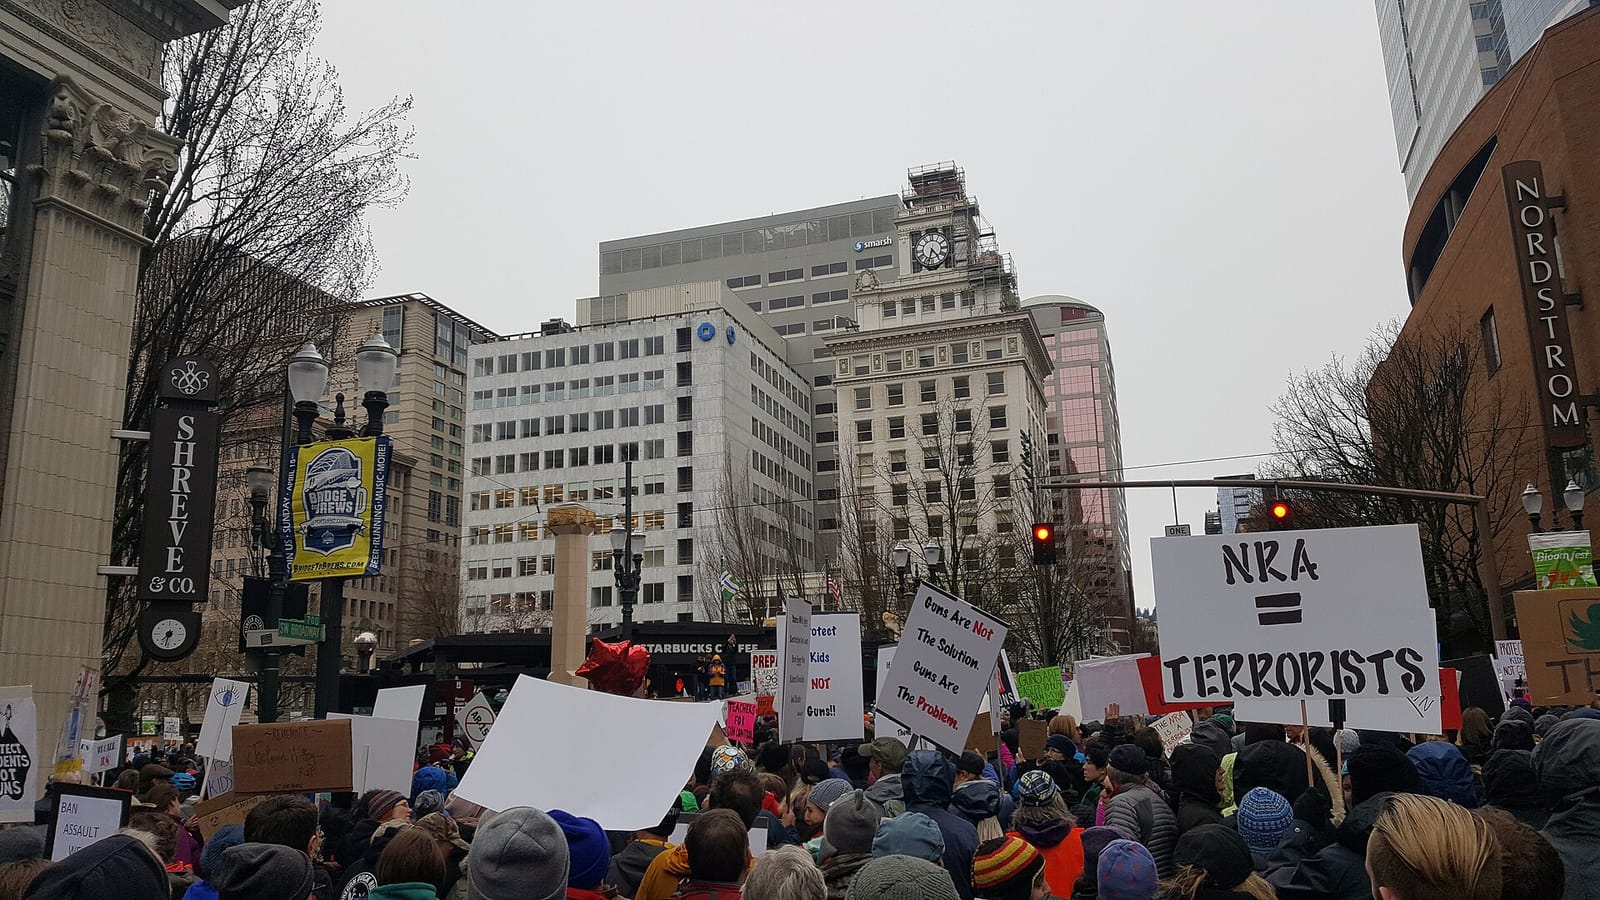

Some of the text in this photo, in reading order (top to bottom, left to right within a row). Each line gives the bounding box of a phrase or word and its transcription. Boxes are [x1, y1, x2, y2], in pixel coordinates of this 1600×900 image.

[864, 236, 892, 248] smarsh
[1515, 177, 1580, 427] NORDSTROM
[165, 416, 196, 573] SHREVE
[282, 497, 291, 533] SUNDAY
[1169, 527, 1188, 535] ONE
[1222, 538, 1319, 585] NRA
[149, 577, 196, 593] & CO.
[924, 596, 994, 641] Guns Are Not
[811, 626, 837, 636] otect
[715, 643, 759, 653] CFEE
[917, 628, 980, 670] The Solution.
[752, 654, 777, 668] PREP
[810, 652, 830, 663] Kids
[913, 660, 960, 694] Guns Are
[1163, 647, 1426, 698] TERRORISTS
[811, 677, 831, 690] NOT
[807, 705, 836, 717] Guns!!
[897, 685, 959, 730] The Problem.
[1154, 711, 1185, 732] THE NRA
[61, 802, 78, 814] BAN
[63, 823, 100, 838] ASSAULT
